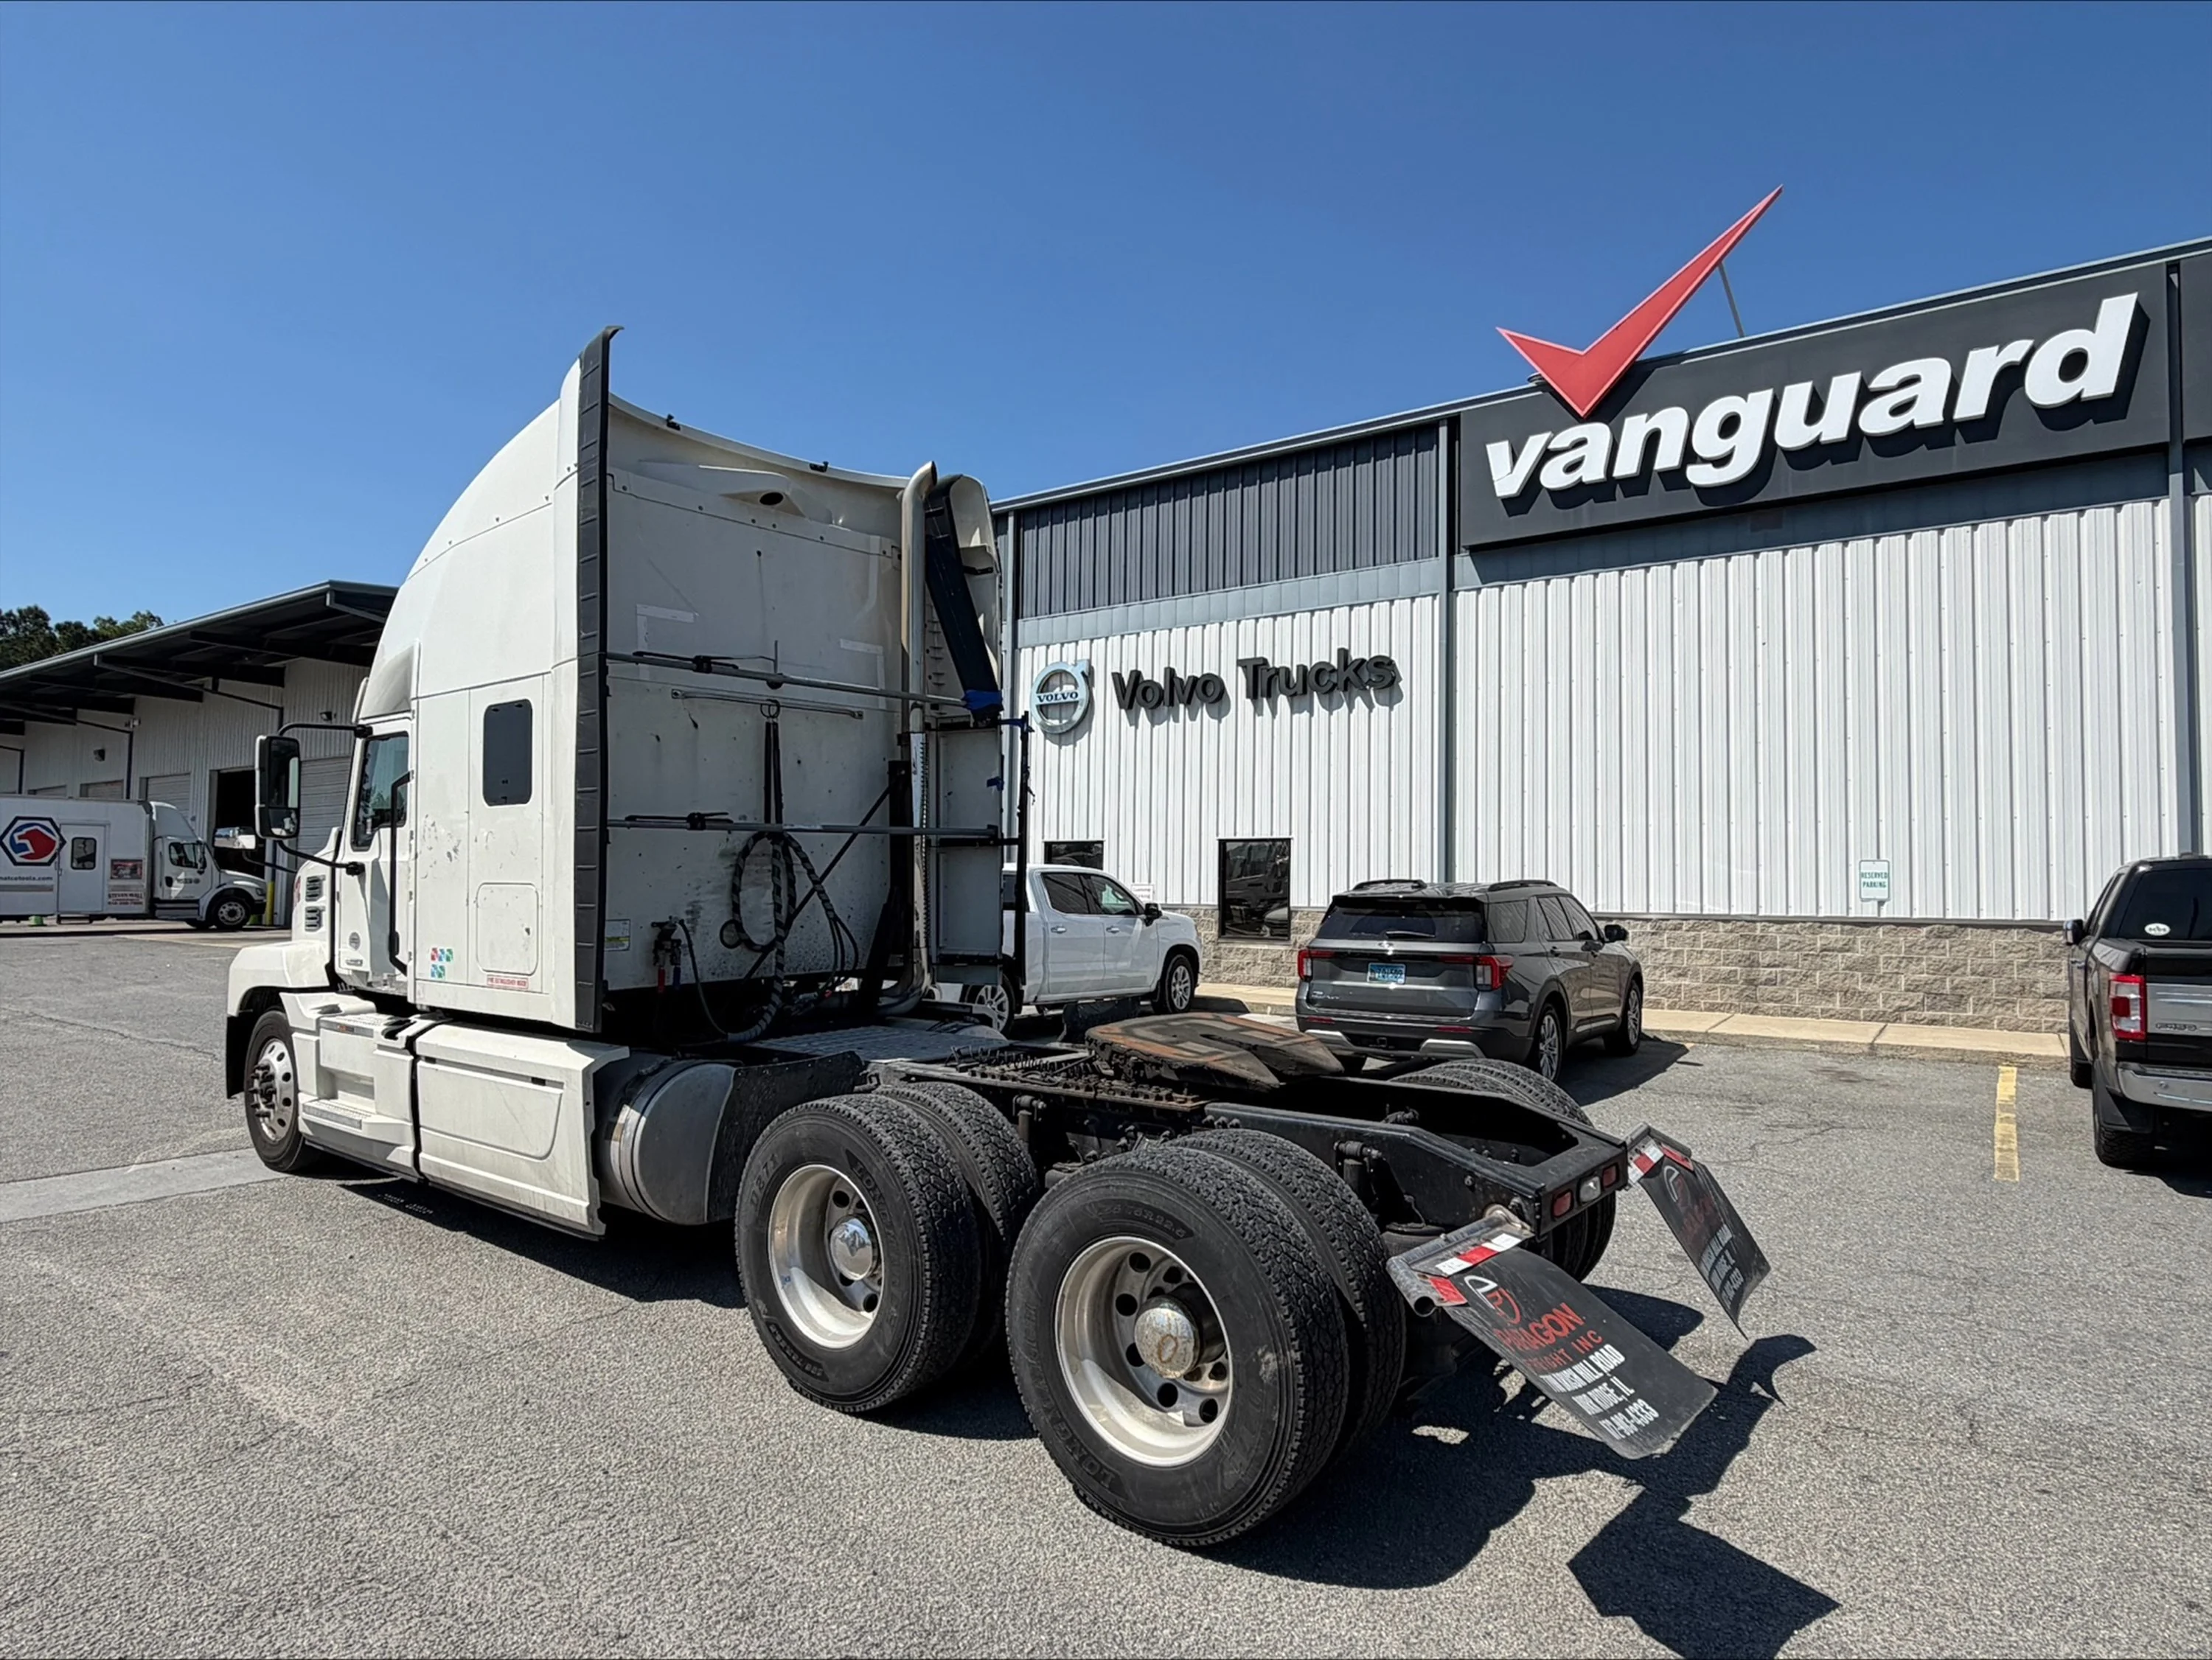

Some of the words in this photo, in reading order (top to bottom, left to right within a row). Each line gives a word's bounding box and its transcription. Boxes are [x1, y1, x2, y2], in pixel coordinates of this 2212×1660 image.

[1486, 292, 2138, 499] vanguard
[1112, 666, 1225, 711] Volvo
[1237, 647, 1397, 700] Trucks
[1037, 689, 1079, 704] VOLVO
[1493, 1302, 1585, 1352] PARAGON
[1571, 1329, 1603, 1354] INC
[1588, 1343, 1626, 1374] ROAD
[1610, 1375, 1635, 1397] IL
